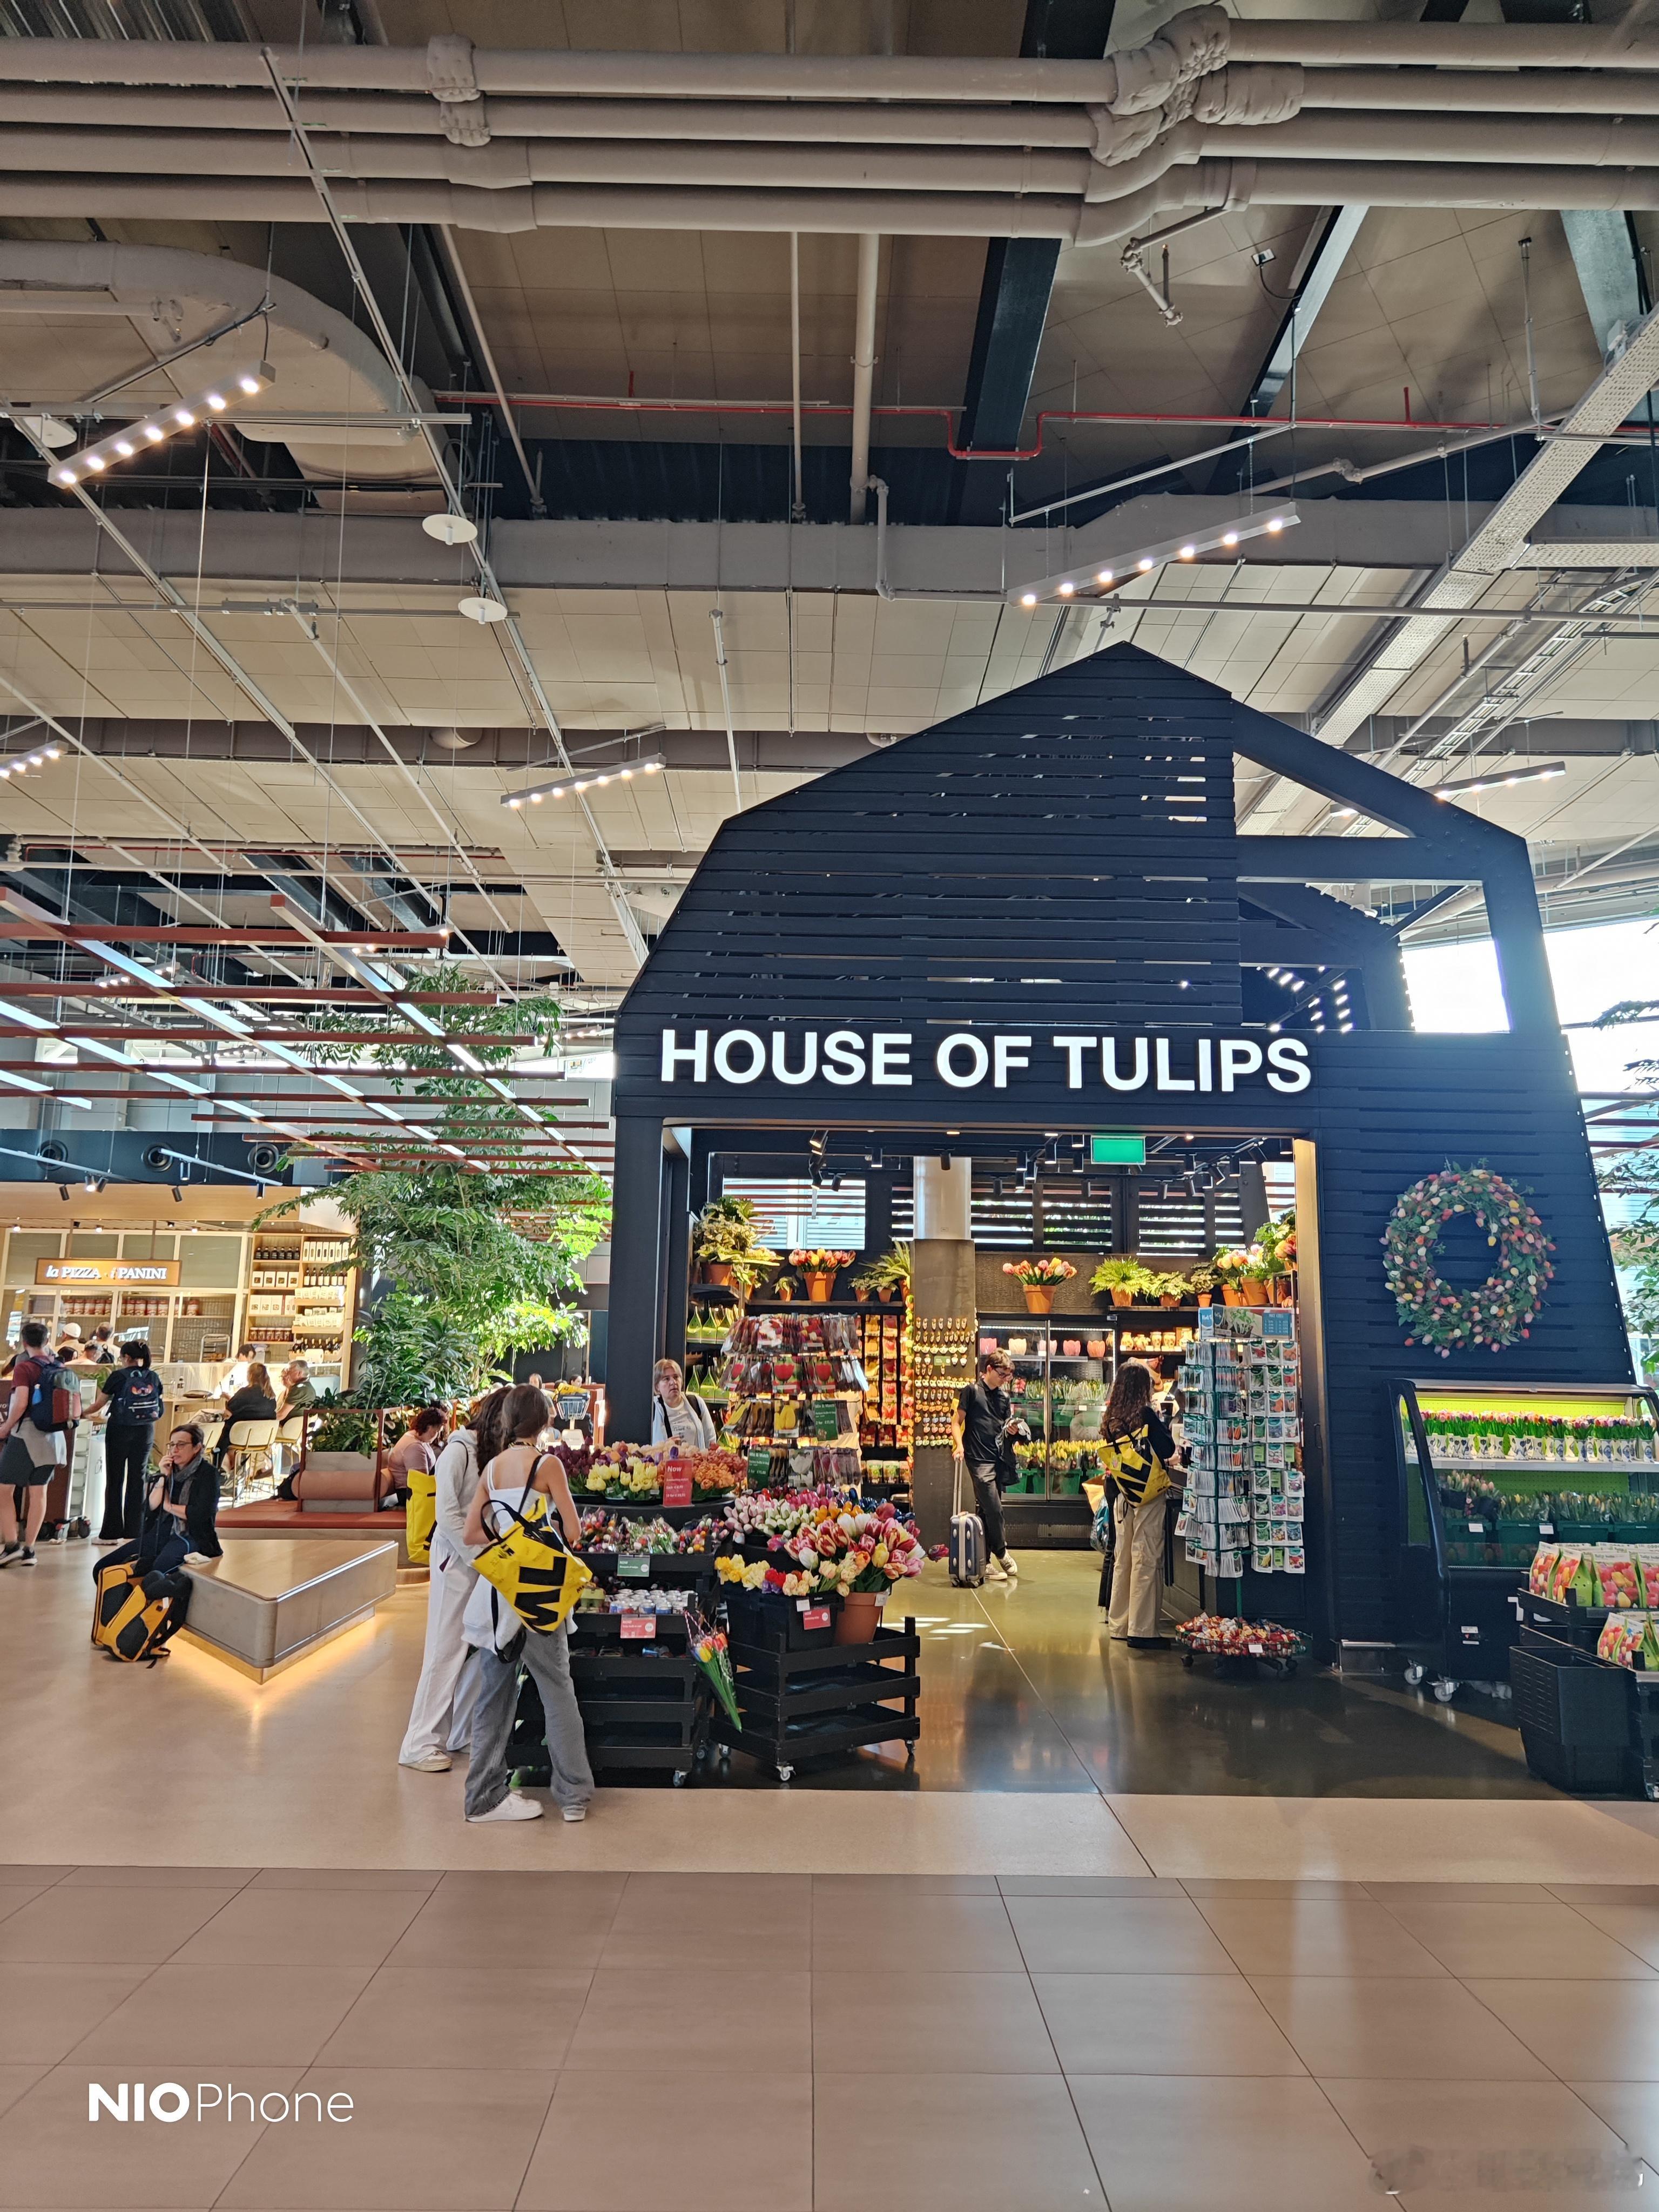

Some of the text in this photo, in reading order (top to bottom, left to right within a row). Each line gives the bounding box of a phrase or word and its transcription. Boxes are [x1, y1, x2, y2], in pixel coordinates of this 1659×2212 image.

[661, 1029, 1311, 1093] HOUSE OF TULIPS
[46, 1265, 59, 1278] la
[62, 1267, 102, 1279] PIZZA
[118, 1267, 168, 1279] PANINI
